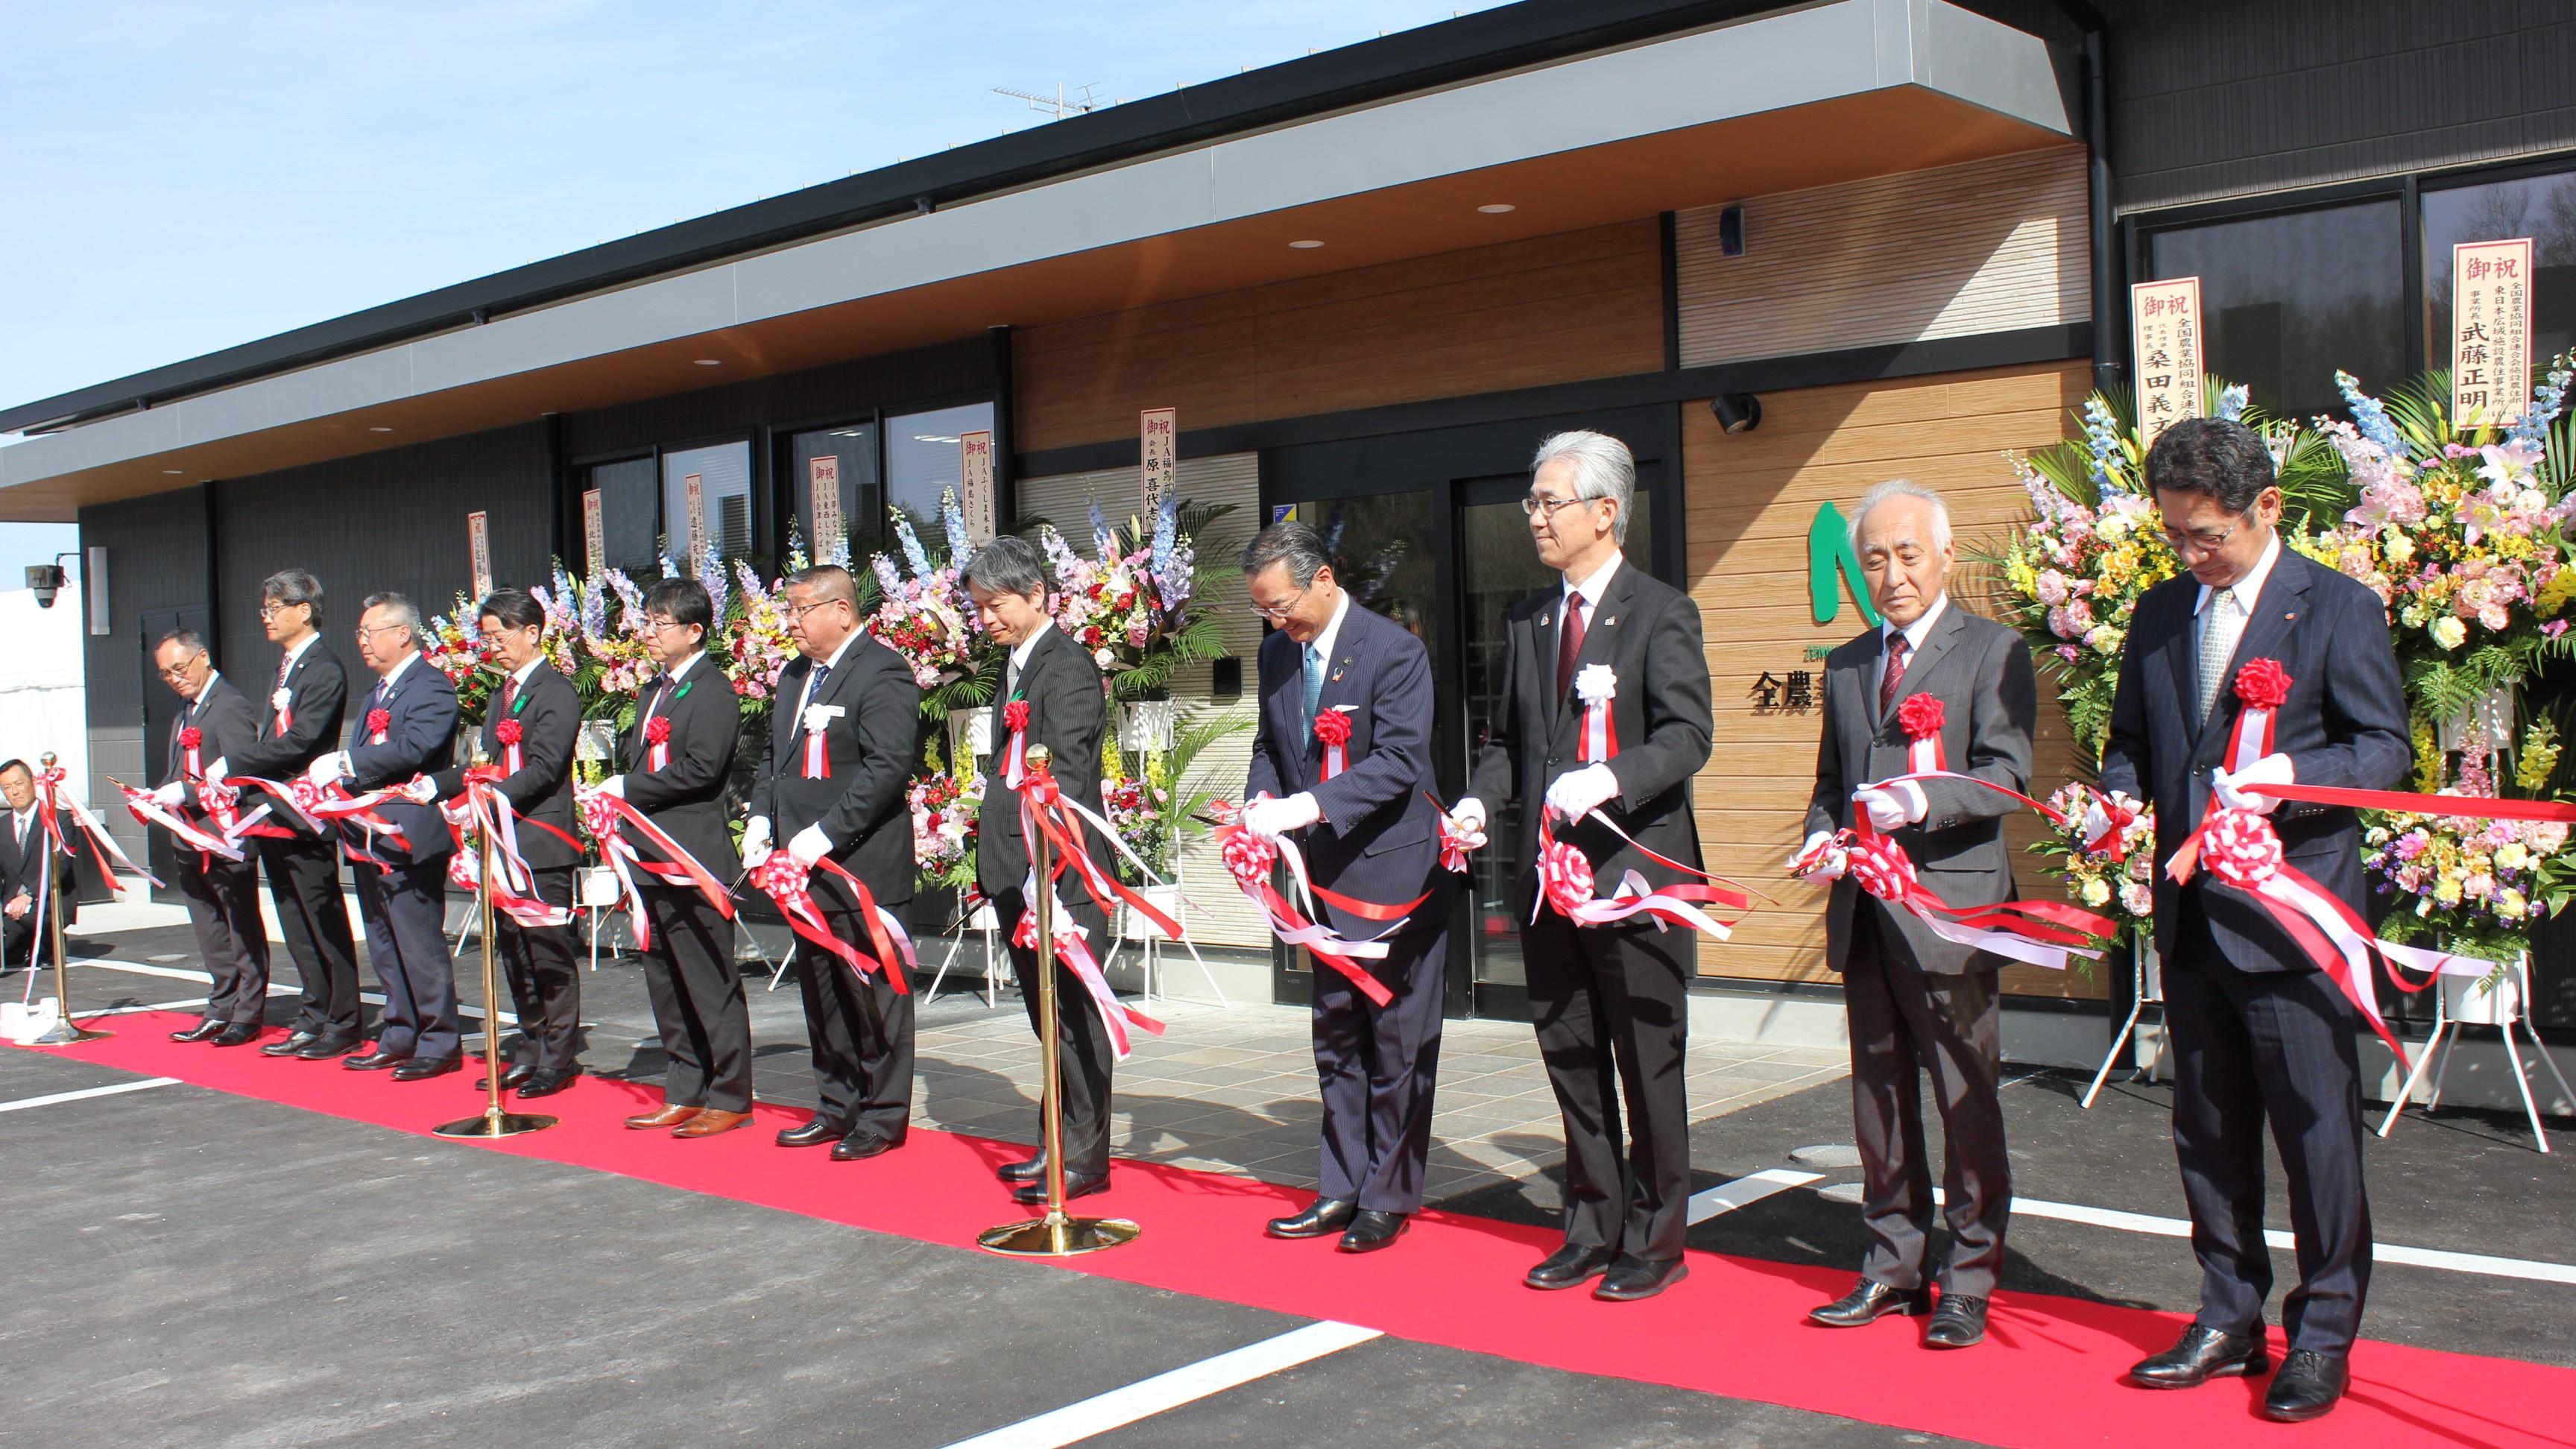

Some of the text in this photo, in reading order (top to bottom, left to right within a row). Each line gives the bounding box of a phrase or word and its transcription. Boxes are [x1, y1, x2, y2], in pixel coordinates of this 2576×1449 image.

[2465, 257, 2519, 281] 御祝
[2143, 294, 2189, 318] 御祝
[2469, 290, 2482, 320] 事業所長
[2492, 285, 2507, 406] 東日本広域施設農住事業所
[2459, 322, 2490, 409] 武藤正明
[2144, 350, 2173, 435] 桑田義文
[1146, 419, 1170, 435] 御祝
[965, 441, 987, 456] 御祝
[1149, 440, 1156, 455] 会長
[815, 466, 834, 480] 御祝
[967, 459, 975, 528] JA福島さくら
[981, 458, 990, 535] JAふくしま未来
[1751, 670, 1824, 707] 全農
